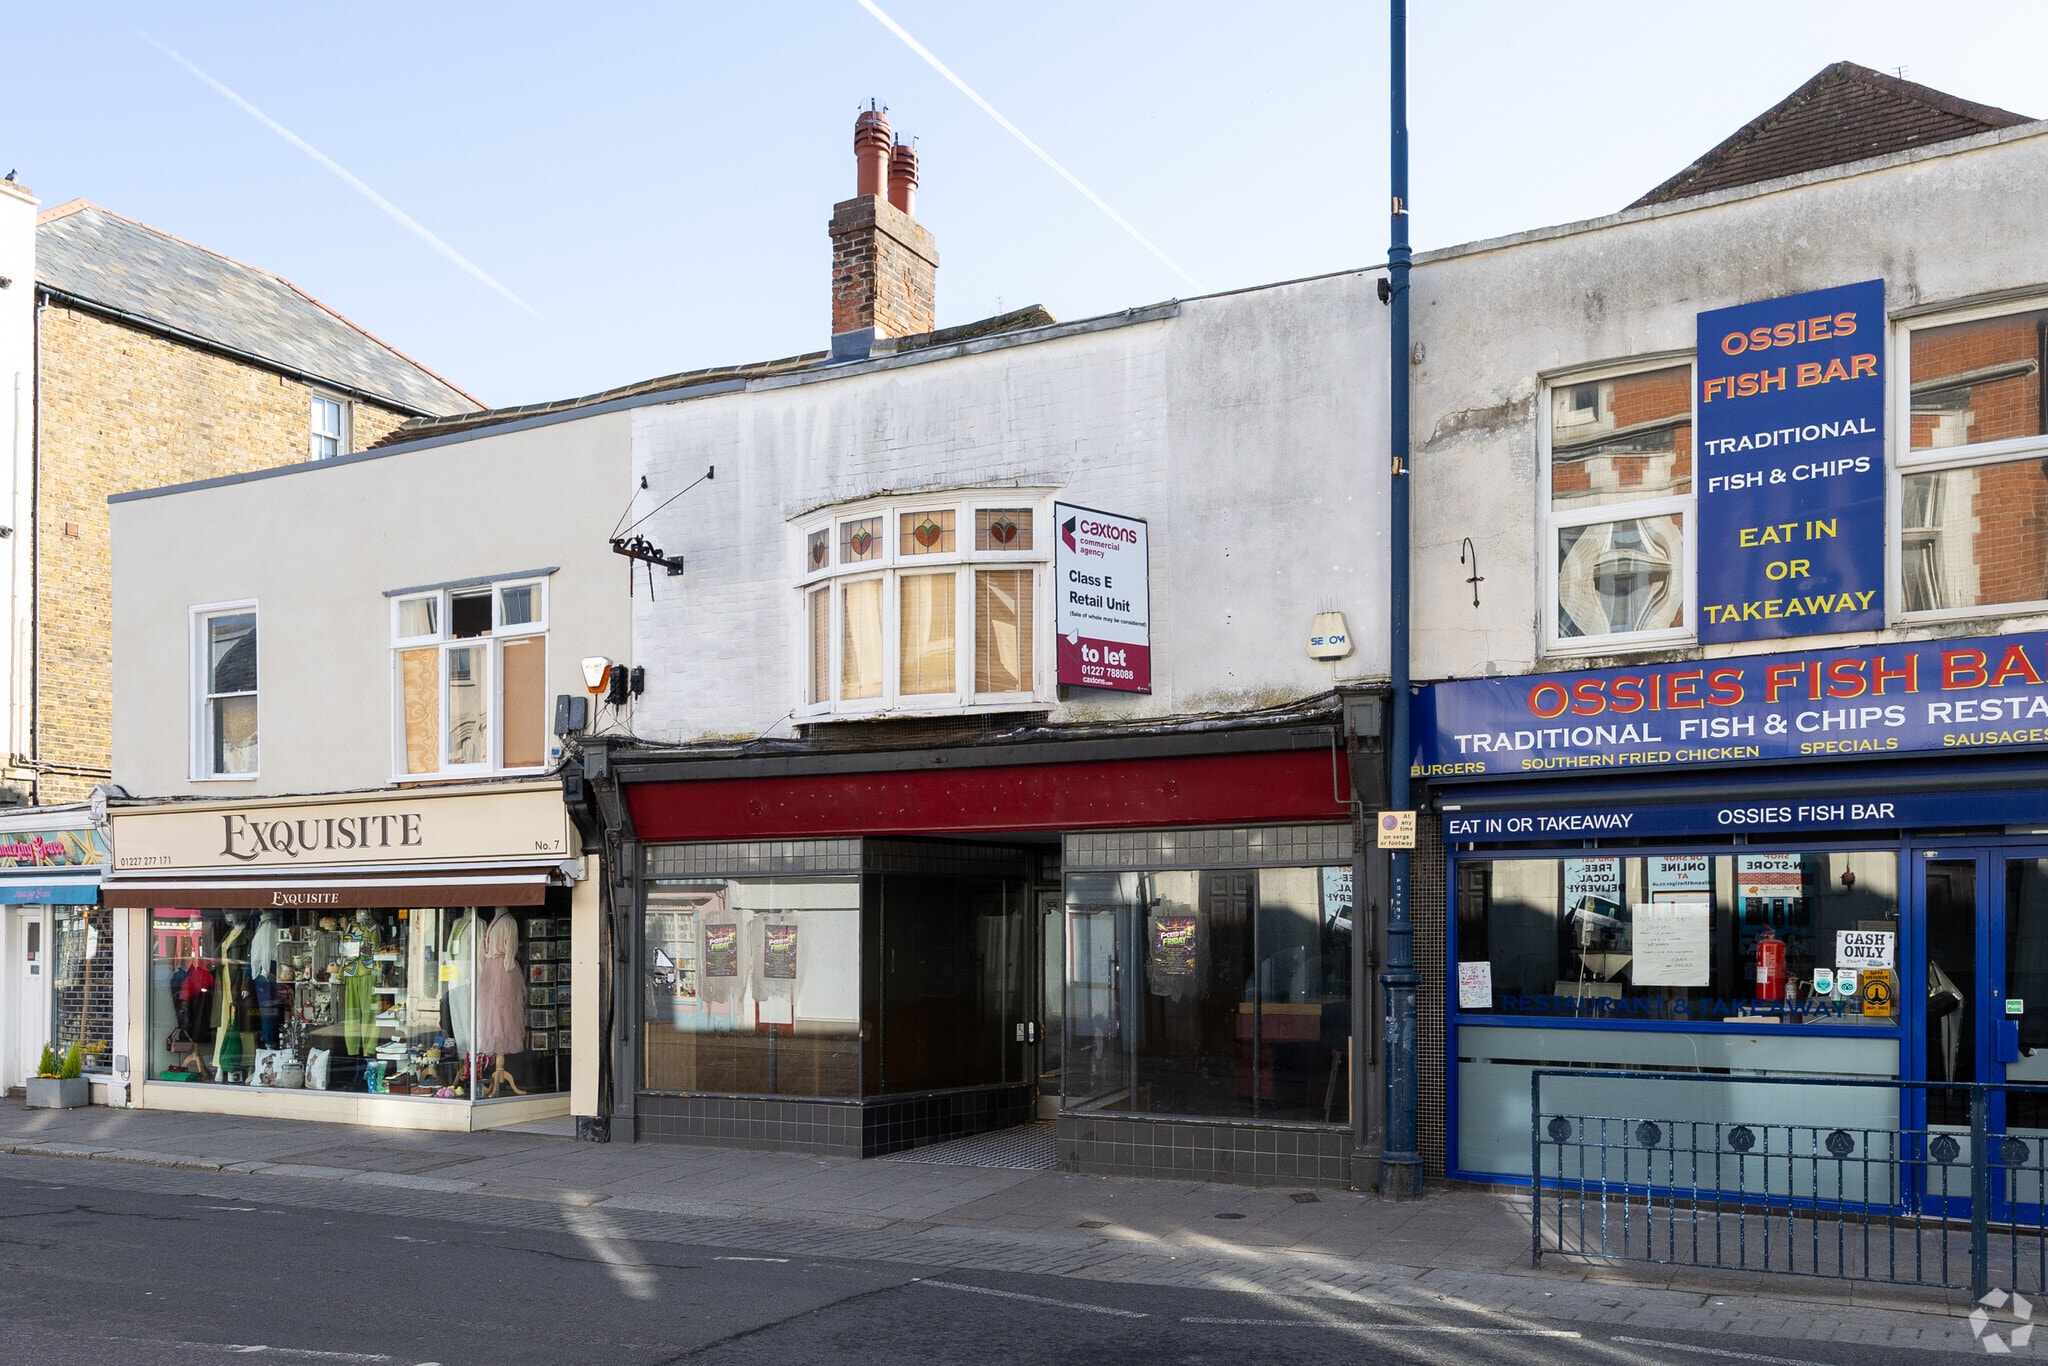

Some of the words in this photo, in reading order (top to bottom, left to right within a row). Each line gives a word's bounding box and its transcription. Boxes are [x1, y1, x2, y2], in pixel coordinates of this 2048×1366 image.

[1721, 311, 1857, 356] OSSIES
[1703, 367, 1786, 404] FISH
[1796, 353, 1878, 389] BAR
[1704, 417, 1876, 456] TRADITIONAL
[1708, 470, 1763, 493] FISH
[1770, 468, 1787, 484] &
[1791, 456, 1871, 483] CHIPS
[1080, 519, 1137, 544] caxtons
[1739, 522, 1798, 549] EAT
[1805, 518, 1838, 541] IN
[1080, 537, 1120, 551] commercial
[1080, 547, 1105, 558] agency
[1069, 569, 1101, 587] Class
[1104, 576, 1112, 588] E
[1765, 559, 1811, 581] OR
[1069, 591, 1103, 608] Retail
[1107, 597, 1130, 612] Unit
[1703, 590, 1876, 625] TAKEAWAY
[1310, 635, 1345, 646] SEOM
[1081, 643, 1099, 663] to
[1103, 646, 1126, 667] let
[1082, 664, 1105, 676] 01227
[1106, 667, 1134, 680] 788088
[1527, 667, 1745, 719] OSSIES
[1765, 653, 1920, 704] FISH
[1941, 643, 2048, 690] BA
[1454, 722, 1662, 754] TRADITIONAL
[1679, 715, 1755, 742] FISH
[1764, 713, 1788, 735] &
[1795, 705, 1906, 733] CHIPS
[1410, 761, 1486, 777] BURGERS
[1521, 754, 1614, 771] SOUTHERN
[1618, 750, 1672, 765] FRIED
[1675, 745, 1760, 762] CHICKEN
[1800, 737, 1899, 755] SPECIALS
[1450, 820, 1481, 834] EAT
[1486, 819, 1502, 833] IN
[1507, 817, 1532, 832] OR
[1537, 813, 1634, 830] TAKEAWAY
[1717, 807, 1792, 824] OSSIES
[1798, 805, 1845, 822] FISH
[1851, 803, 1895, 820] BAR
[218, 813, 423, 861] EXQUISITE
[534, 840, 551, 851] No.
[554, 839, 560, 850] 7
[121, 857, 141, 866] 01227
[143, 856, 158, 866] 277
[159, 855, 172, 865] 171
[272, 891, 339, 907] EXQUISITE
[1844, 933, 1885, 945] CASH
[1844, 946, 1885, 958] ONLY
[1501, 995, 1666, 1014] RESTAURANT
[1674, 998, 1690, 1014] &
[1700, 997, 1849, 1019] TAKEAWAY
